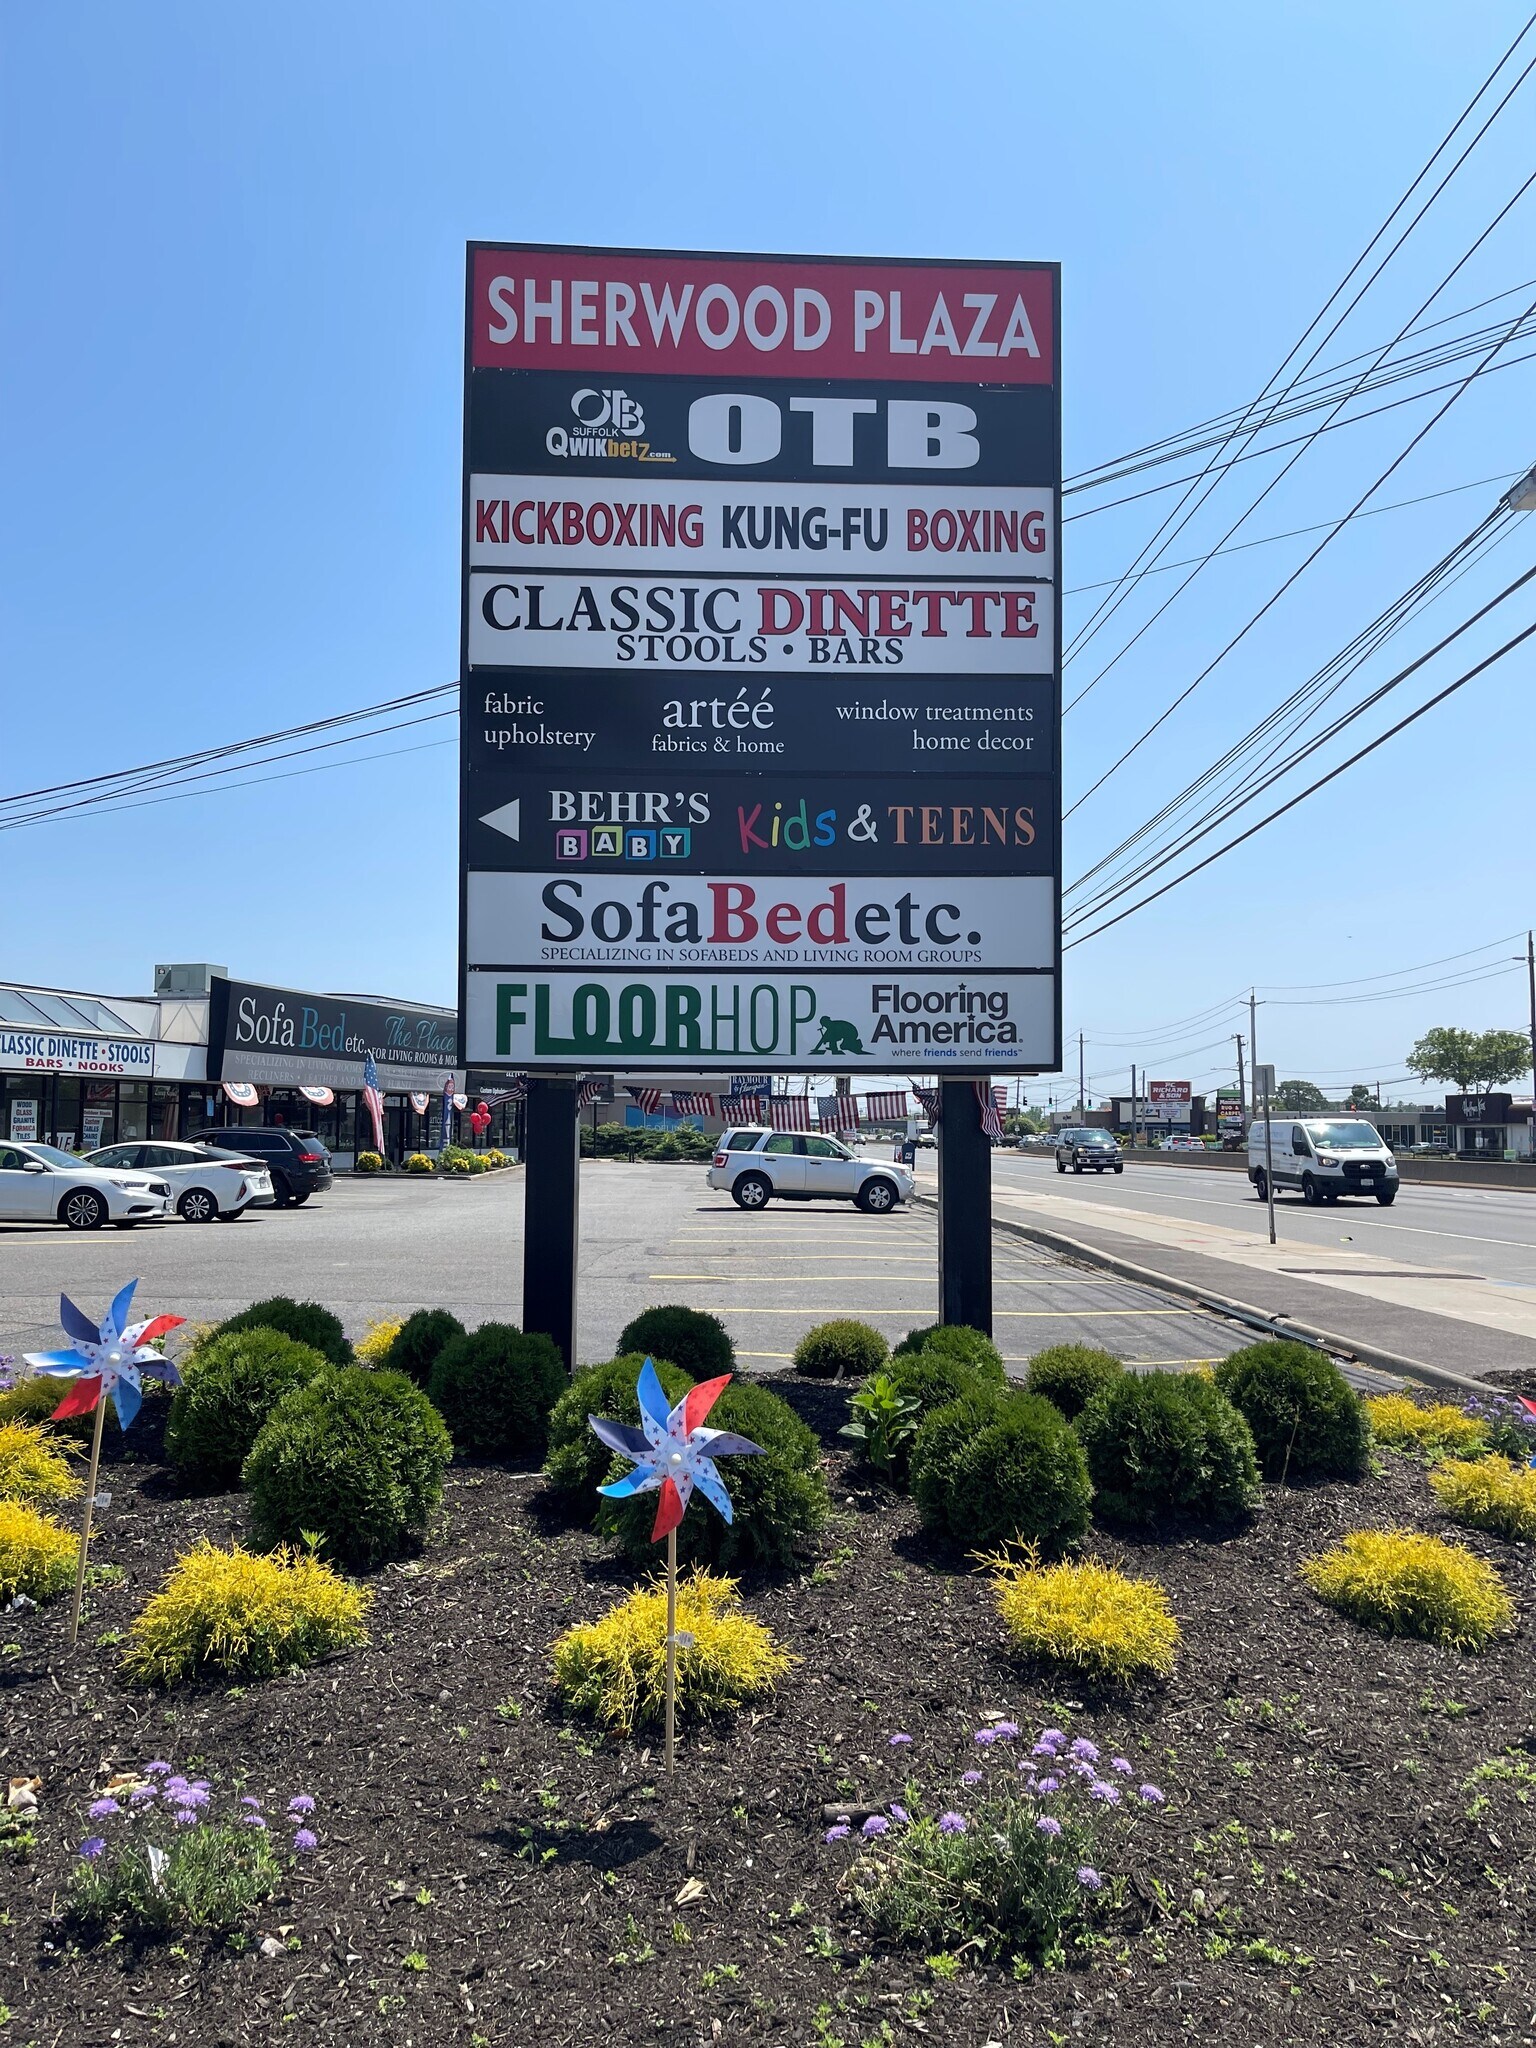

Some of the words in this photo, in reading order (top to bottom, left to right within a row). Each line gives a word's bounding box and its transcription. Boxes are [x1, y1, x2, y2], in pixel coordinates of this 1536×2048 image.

[488, 276, 832, 351] SHERWOOD
[854, 289, 1041, 358] PLAZA
[572, 427, 619, 437] SUFFOLK
[688, 393, 981, 470] OTB
[475, 499, 704, 548] KICKBOXING
[722, 504, 888, 552] KUNG-FU
[907, 509, 1046, 554] BOXING
[481, 584, 742, 634] CLASSIC
[758, 587, 1039, 640] DINETTE
[616, 635, 768, 664] STOOLS
[808, 637, 904, 665] BARS
[484, 692, 544, 716] fabric
[662, 686, 775, 730] artéé
[836, 701, 919, 722] window
[926, 703, 1034, 723] treatments
[484, 725, 596, 753] upholstery
[651, 735, 710, 754] fabrics
[714, 736, 731, 754] &
[736, 735, 785, 754] home
[912, 730, 971, 751] home
[978, 730, 1034, 751] decor
[737, 799, 837, 854] Kids
[847, 803, 879, 844] &
[888, 806, 1036, 847] TEENS
[559, 829, 688, 859] BABY
[541, 947, 653, 962] SPECIALIZING
[656, 948, 675, 962] IN
[679, 948, 759, 963] SOFABEDS
[763, 948, 799, 963] AND
[803, 948, 859, 963] LIVING
[863, 948, 913, 963] ROOM
[917, 949, 982, 963] GROUPS
[872, 983, 1009, 1021] Flooring
[48, 1038, 98, 1060] DINETTE
[108, 1043, 150, 1064] STOOLS
[235, 1054, 294, 1068] SPECIALIZING
[388, 1049, 413, 1063] LIVING
[414, 1053, 438, 1065] ROOMS
[892, 1049, 921, 1057] where
[924, 1048, 957, 1057] friends
[960, 1048, 982, 1057] send
[25, 1058, 63, 1068] BARS
[78, 1062, 124, 1072] NOOKS
